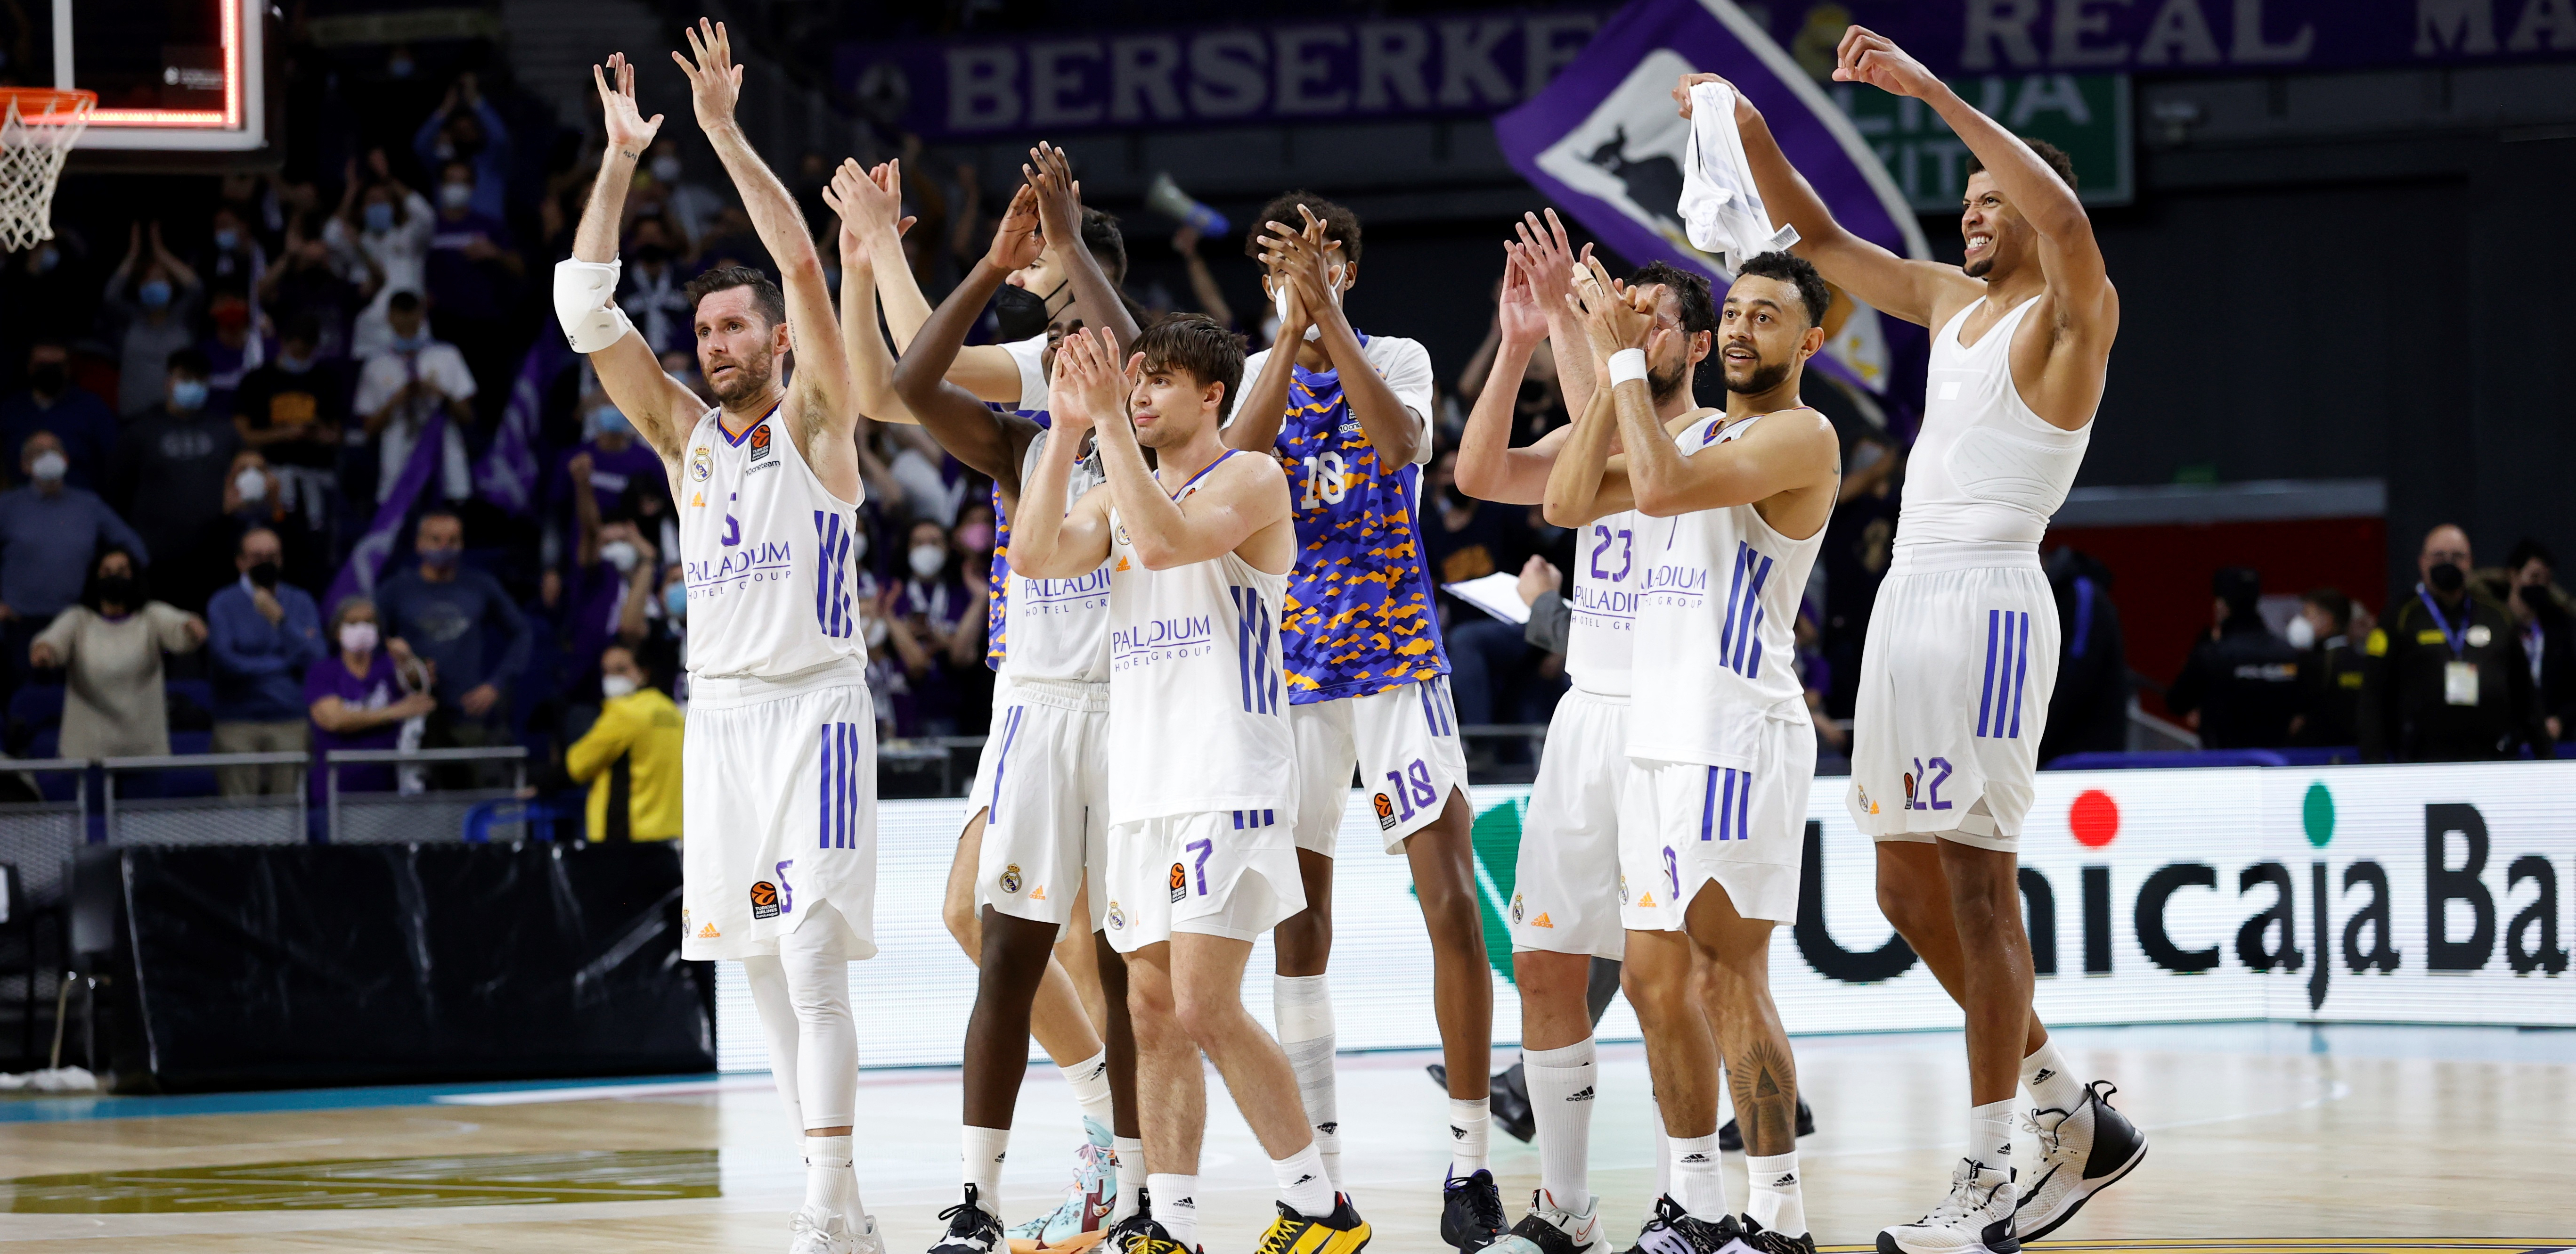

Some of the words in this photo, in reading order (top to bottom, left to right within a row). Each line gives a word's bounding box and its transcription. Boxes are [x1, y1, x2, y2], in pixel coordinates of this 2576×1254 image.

[1957, 0, 2316, 71] REAL
[752, 445, 769, 454] TURKISH
[752, 449, 768, 458] AIRLINES
[745, 460, 780, 476] 10oneteam
[1301, 451, 1345, 510] 18
[1591, 525, 1633, 582] 23
[688, 586, 725, 600] HOTEL
[739, 570, 791, 590] GOUP
[1658, 596, 1703, 608] GROUP
[1026, 604, 1069, 617] HOTEL
[1571, 615, 1600, 628] HOTEL
[1115, 656, 1150, 672] HOEL
[1151, 646, 1211, 660] GROUP
[1386, 758, 1438, 823] 18
[1186, 837, 1213, 896] 7
[1531, 921, 1554, 929] adidas
[2033, 1070, 2056, 1086] adidas
[1565, 1094, 1595, 1102] adidas
